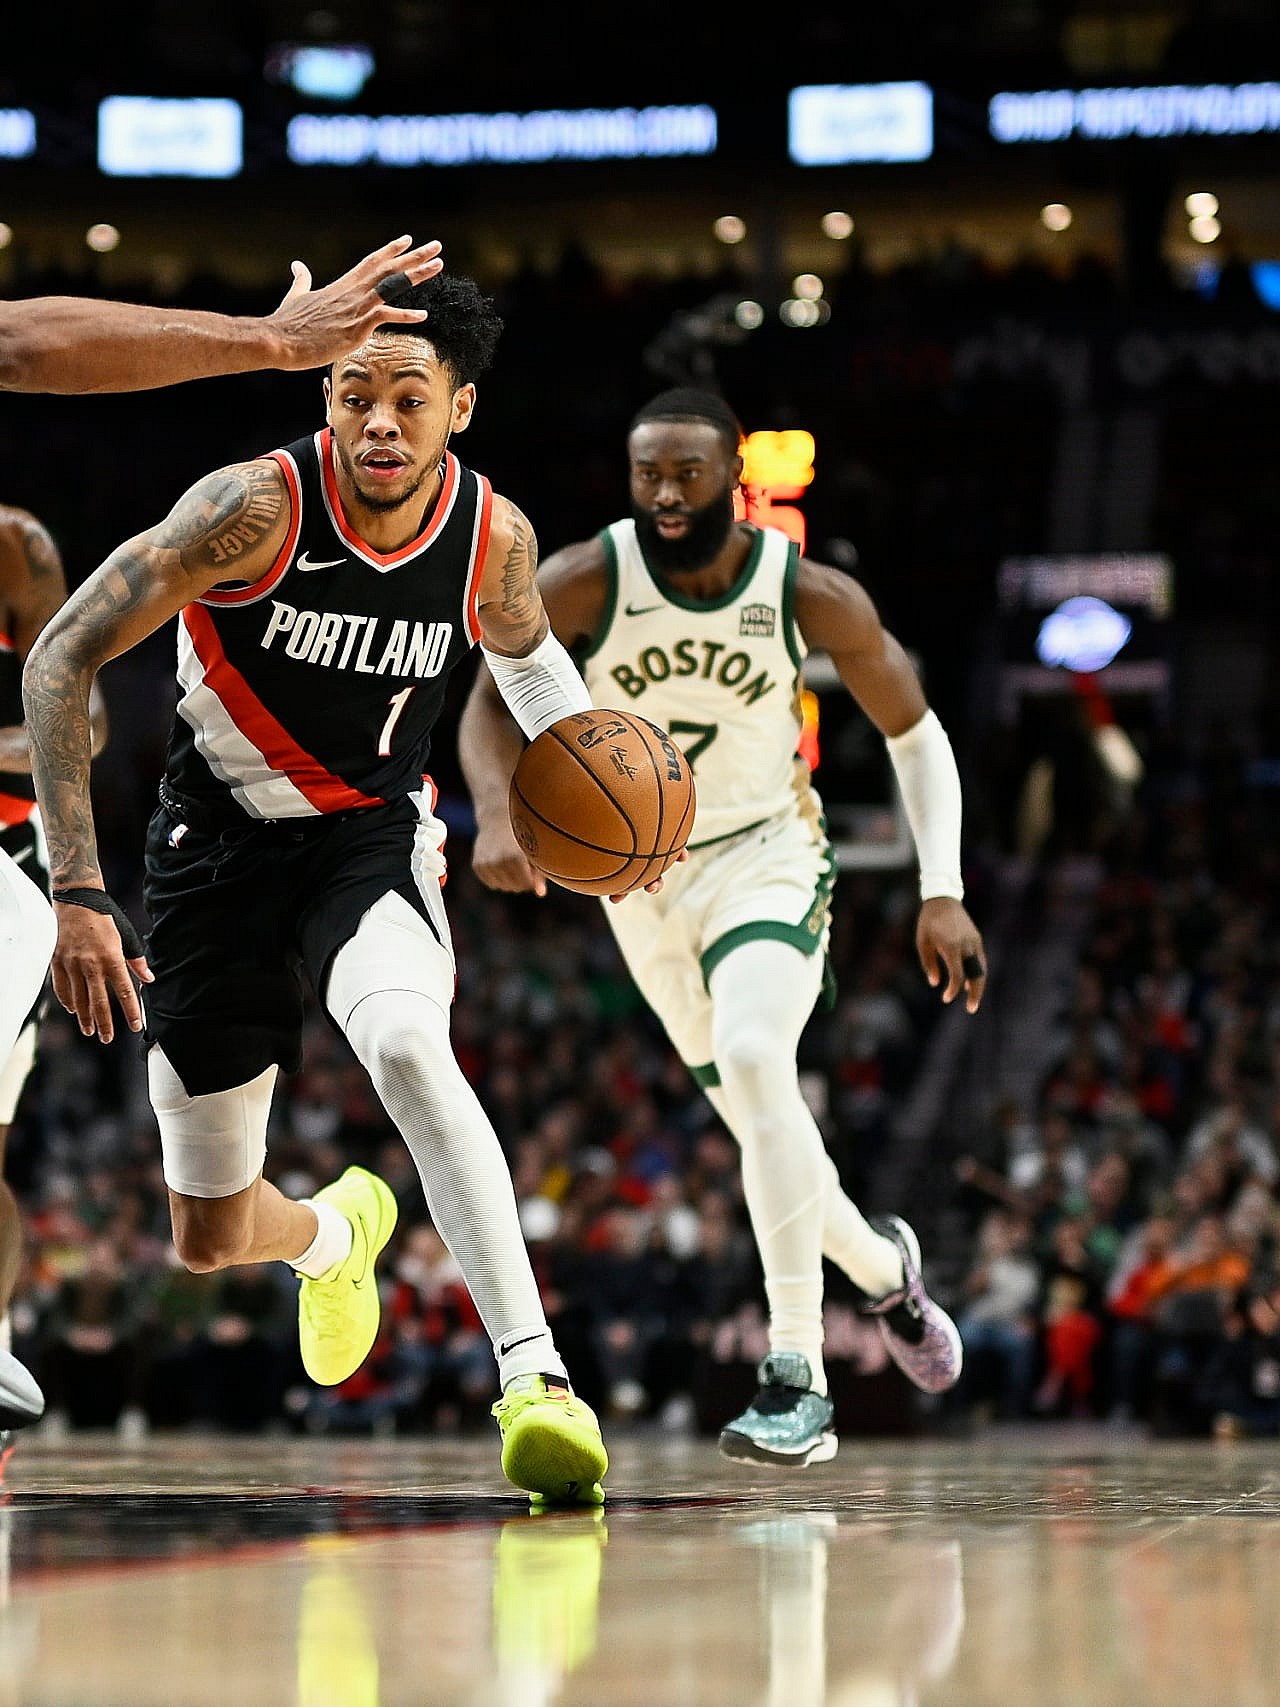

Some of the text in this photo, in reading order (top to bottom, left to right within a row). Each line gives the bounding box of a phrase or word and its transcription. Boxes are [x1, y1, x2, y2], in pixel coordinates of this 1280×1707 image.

[260, 600, 453, 678] PORTLAND
[610, 638, 776, 706] BOSTON
[378, 686, 416, 757] 1
[668, 720, 718, 776] 7
